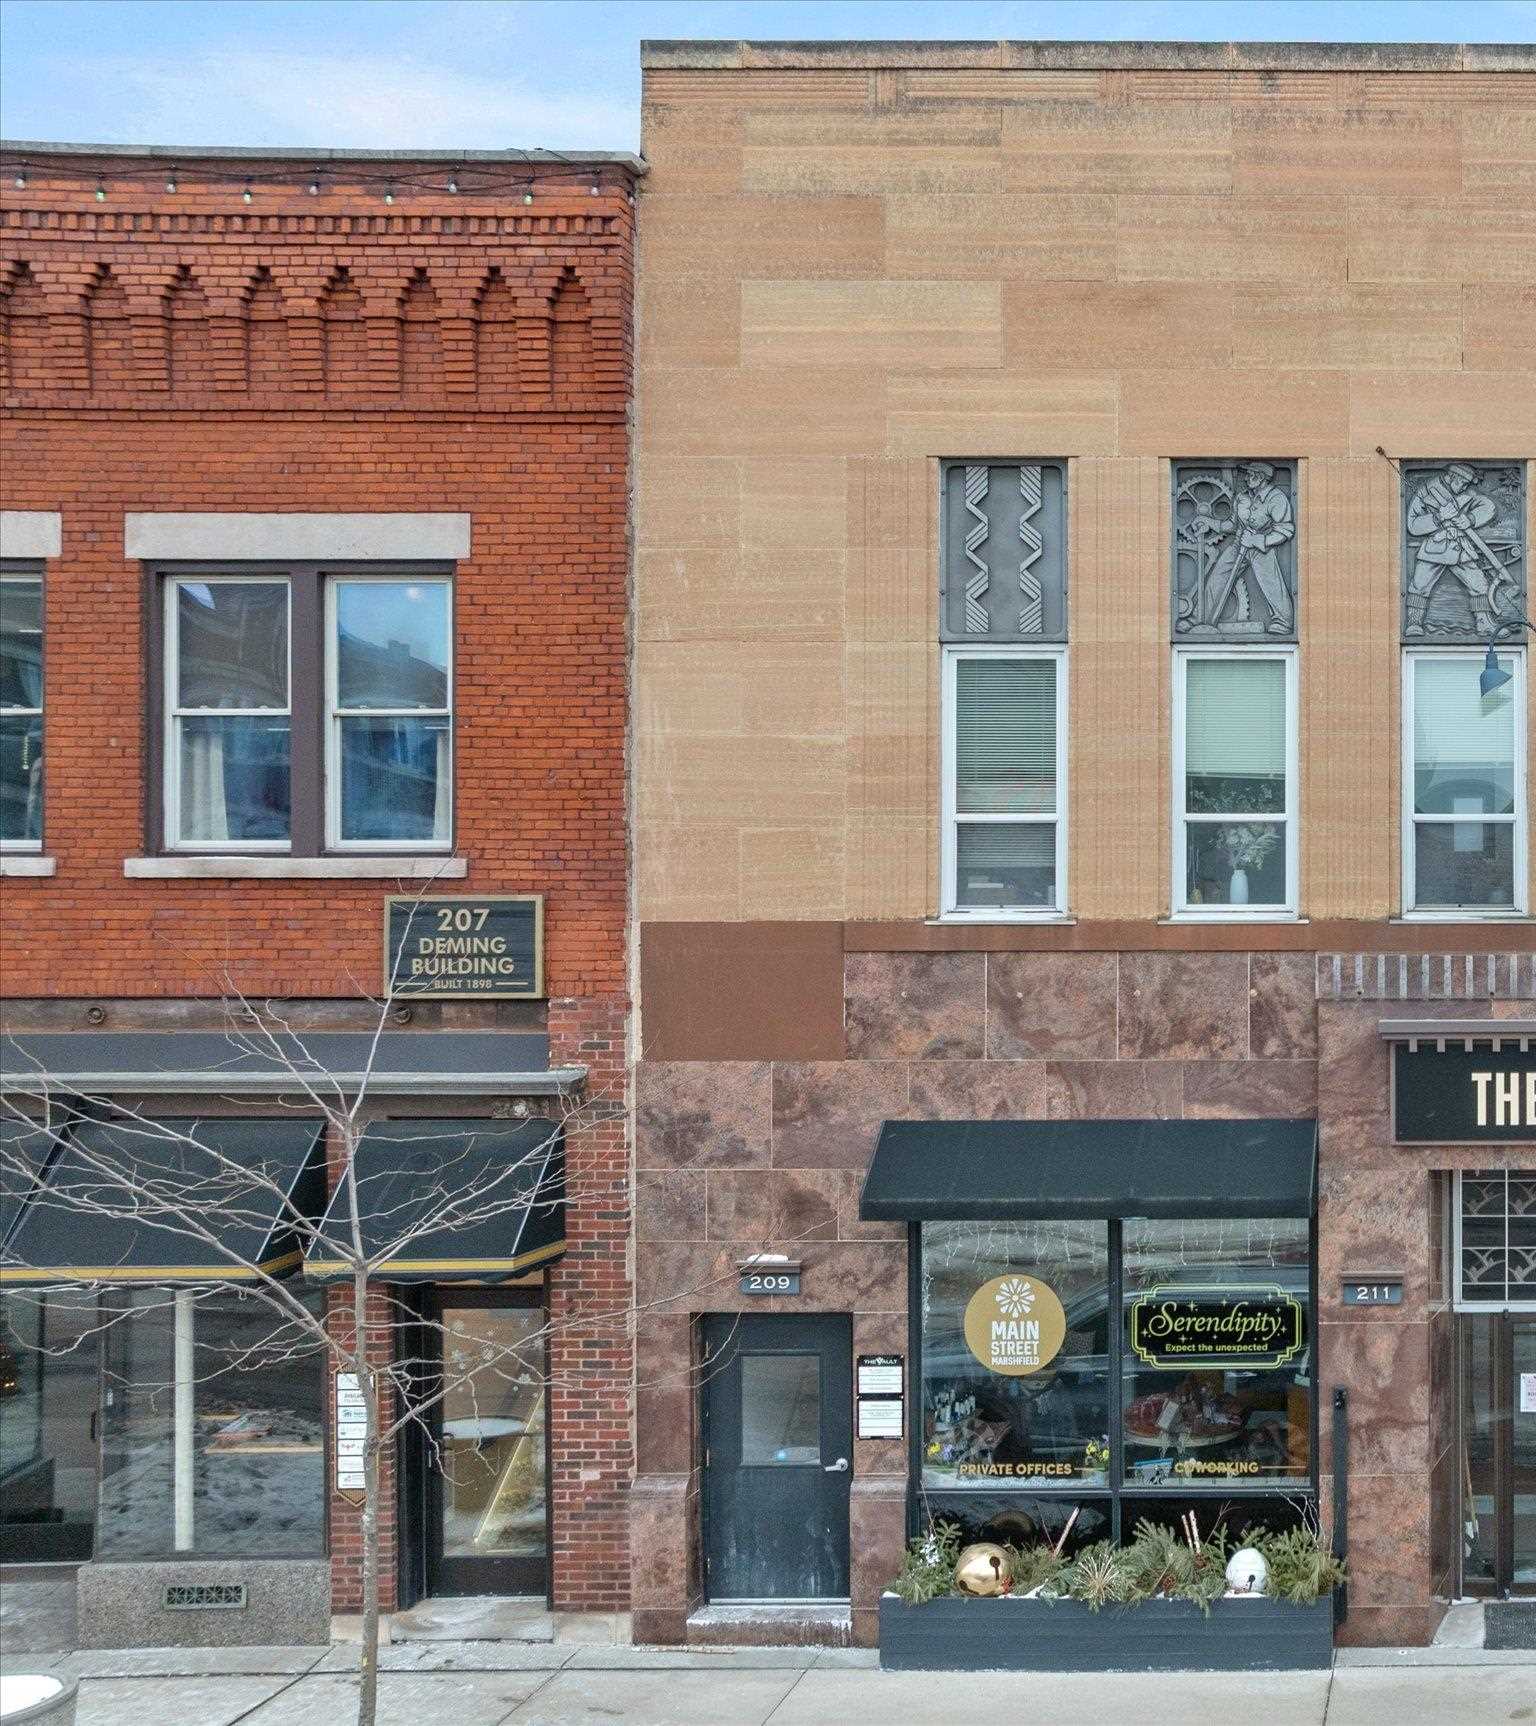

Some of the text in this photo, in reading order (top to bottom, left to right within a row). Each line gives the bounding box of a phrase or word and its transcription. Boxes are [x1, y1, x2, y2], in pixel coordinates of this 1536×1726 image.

[437, 908, 490, 932] 207
[419, 936, 507, 955] DEMING
[411, 957, 514, 975] BUILDING
[434, 979, 493, 989] BUILT 1898
[750, 1276, 790, 1289] 209
[1357, 1286, 1389, 1300] 211
[1149, 1301, 1282, 1342] Serendipity
[991, 1320, 1040, 1340] MAIN
[991, 1341, 1039, 1355] STREET
[1165, 1343, 1268, 1354] Expect the unexpected
[991, 1356, 1040, 1365] MARSHFIELD
[960, 1462, 1072, 1476] PRIVATE OFFICES
[1175, 1461, 1259, 1474] COWORKING
